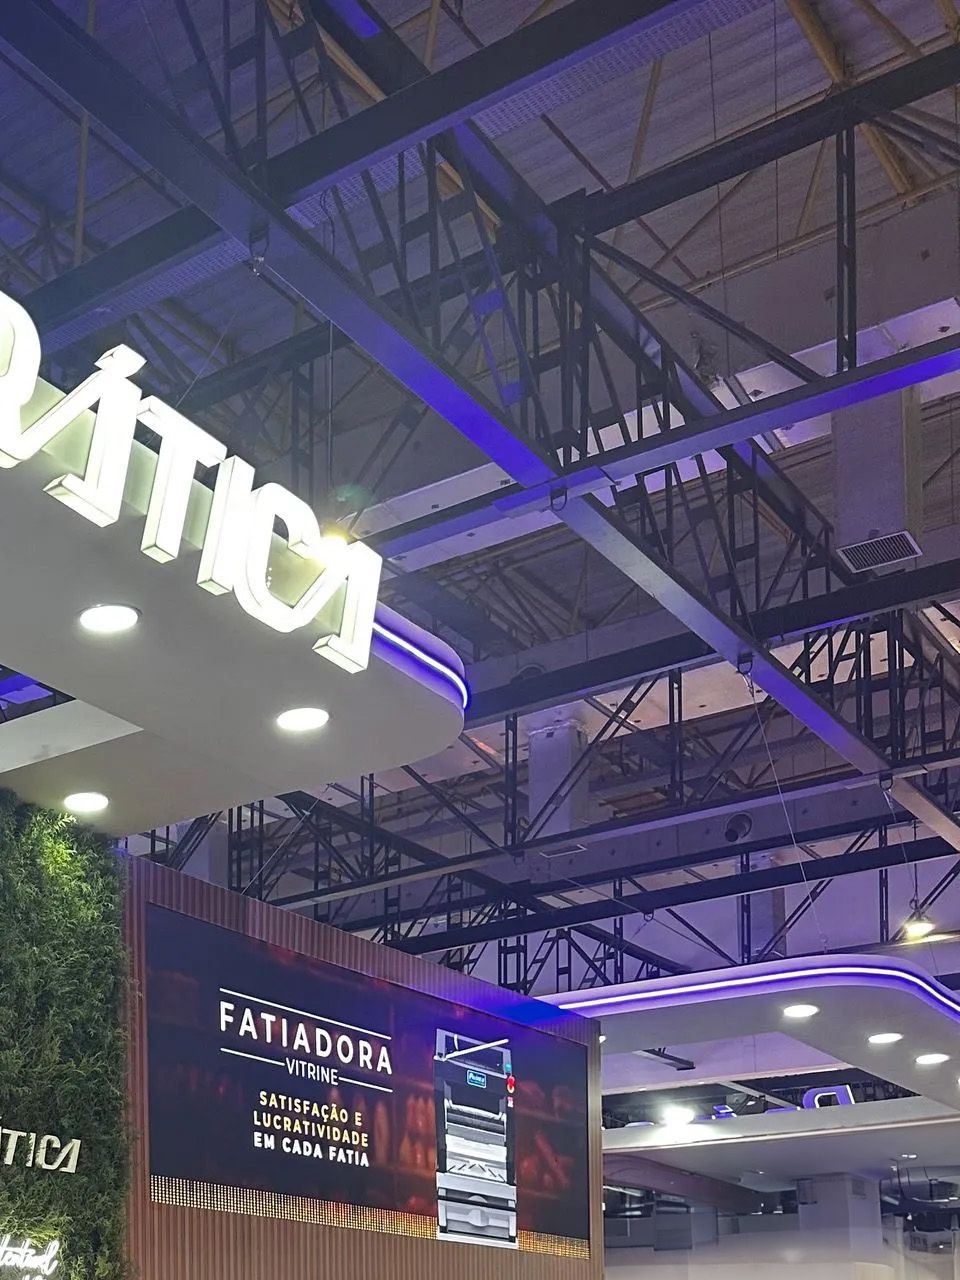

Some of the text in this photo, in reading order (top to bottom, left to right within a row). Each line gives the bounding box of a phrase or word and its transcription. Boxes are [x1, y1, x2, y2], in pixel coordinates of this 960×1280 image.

[219, 1000, 393, 1075] FATIADORA
[285, 1057, 339, 1086] VITRINE
[259, 1090, 362, 1127] SATISFAÇÃO E
[253, 1111, 368, 1147] LUCRATIVIDADE
[253, 1131, 369, 1168] EM CADA FATIA
